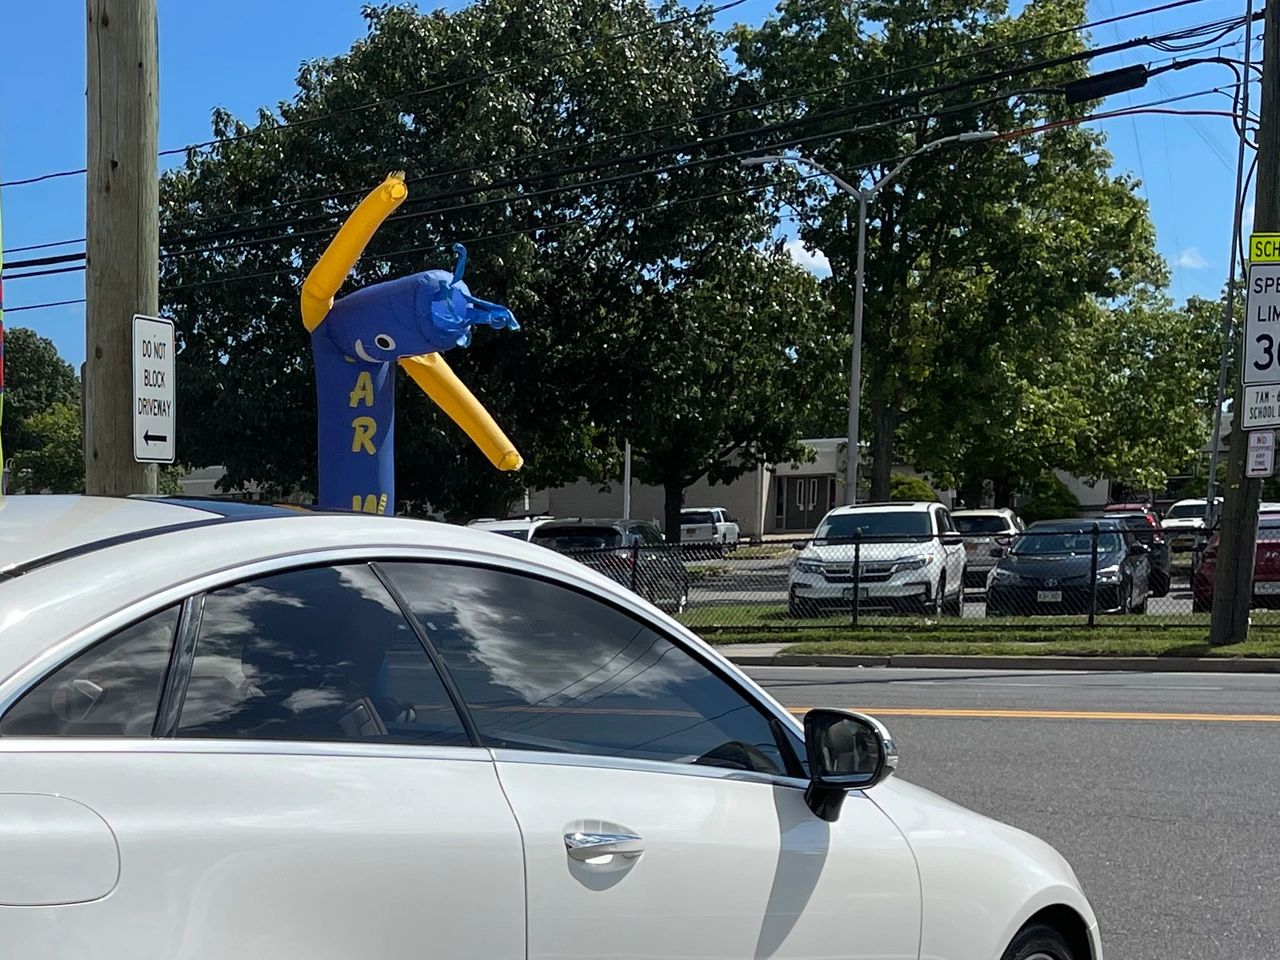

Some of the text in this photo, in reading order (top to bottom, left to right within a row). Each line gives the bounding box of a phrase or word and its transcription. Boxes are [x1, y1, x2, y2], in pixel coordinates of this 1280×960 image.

[142, 340, 166, 359] DO NOT
[144, 369, 166, 388] BLOCK
[1255, 391, 1270, 404] 7AM
[138, 397, 172, 418] DRIVEWAY
[1249, 406, 1276, 420] SCHOOL
[1256, 436, 1267, 445] NO
